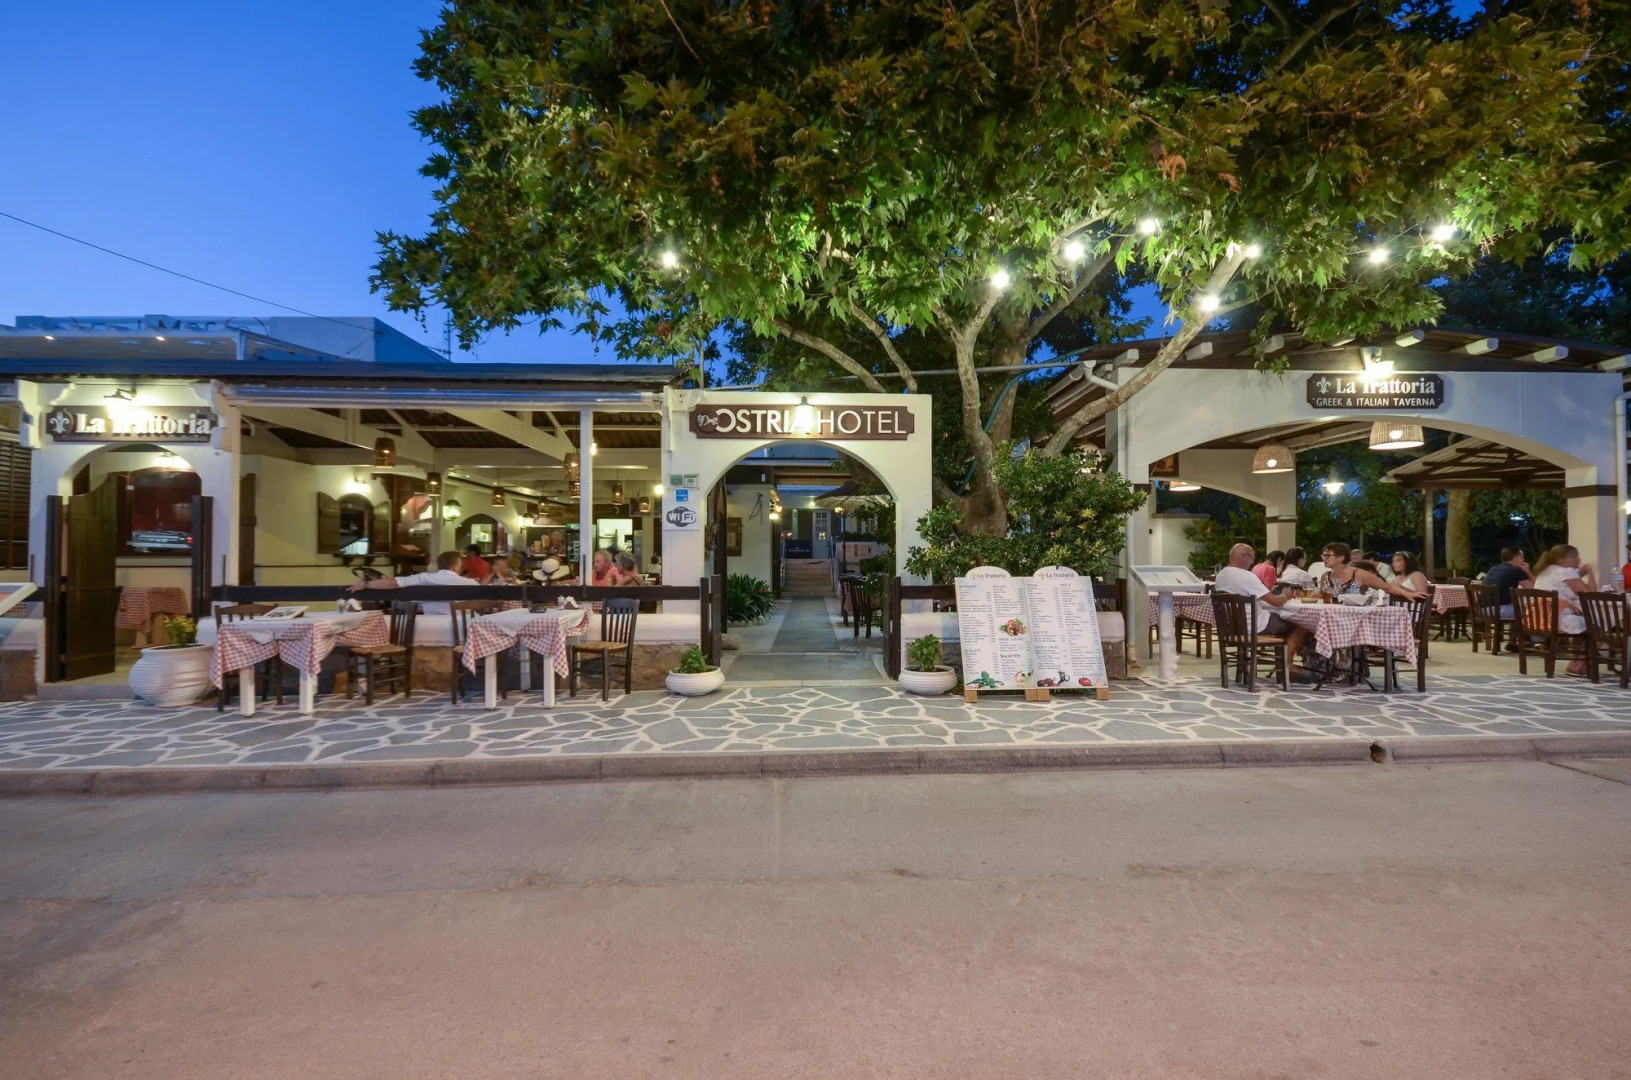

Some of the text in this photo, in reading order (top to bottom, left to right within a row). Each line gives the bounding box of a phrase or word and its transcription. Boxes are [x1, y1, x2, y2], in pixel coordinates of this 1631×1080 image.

[1335, 377, 1436, 394] La Trattoria
[1316, 397, 1436, 407] GREEK & ITALIAN TAVERNA
[75, 413, 106, 433] La
[715, 408, 907, 434] OSTRIA HOTEL
